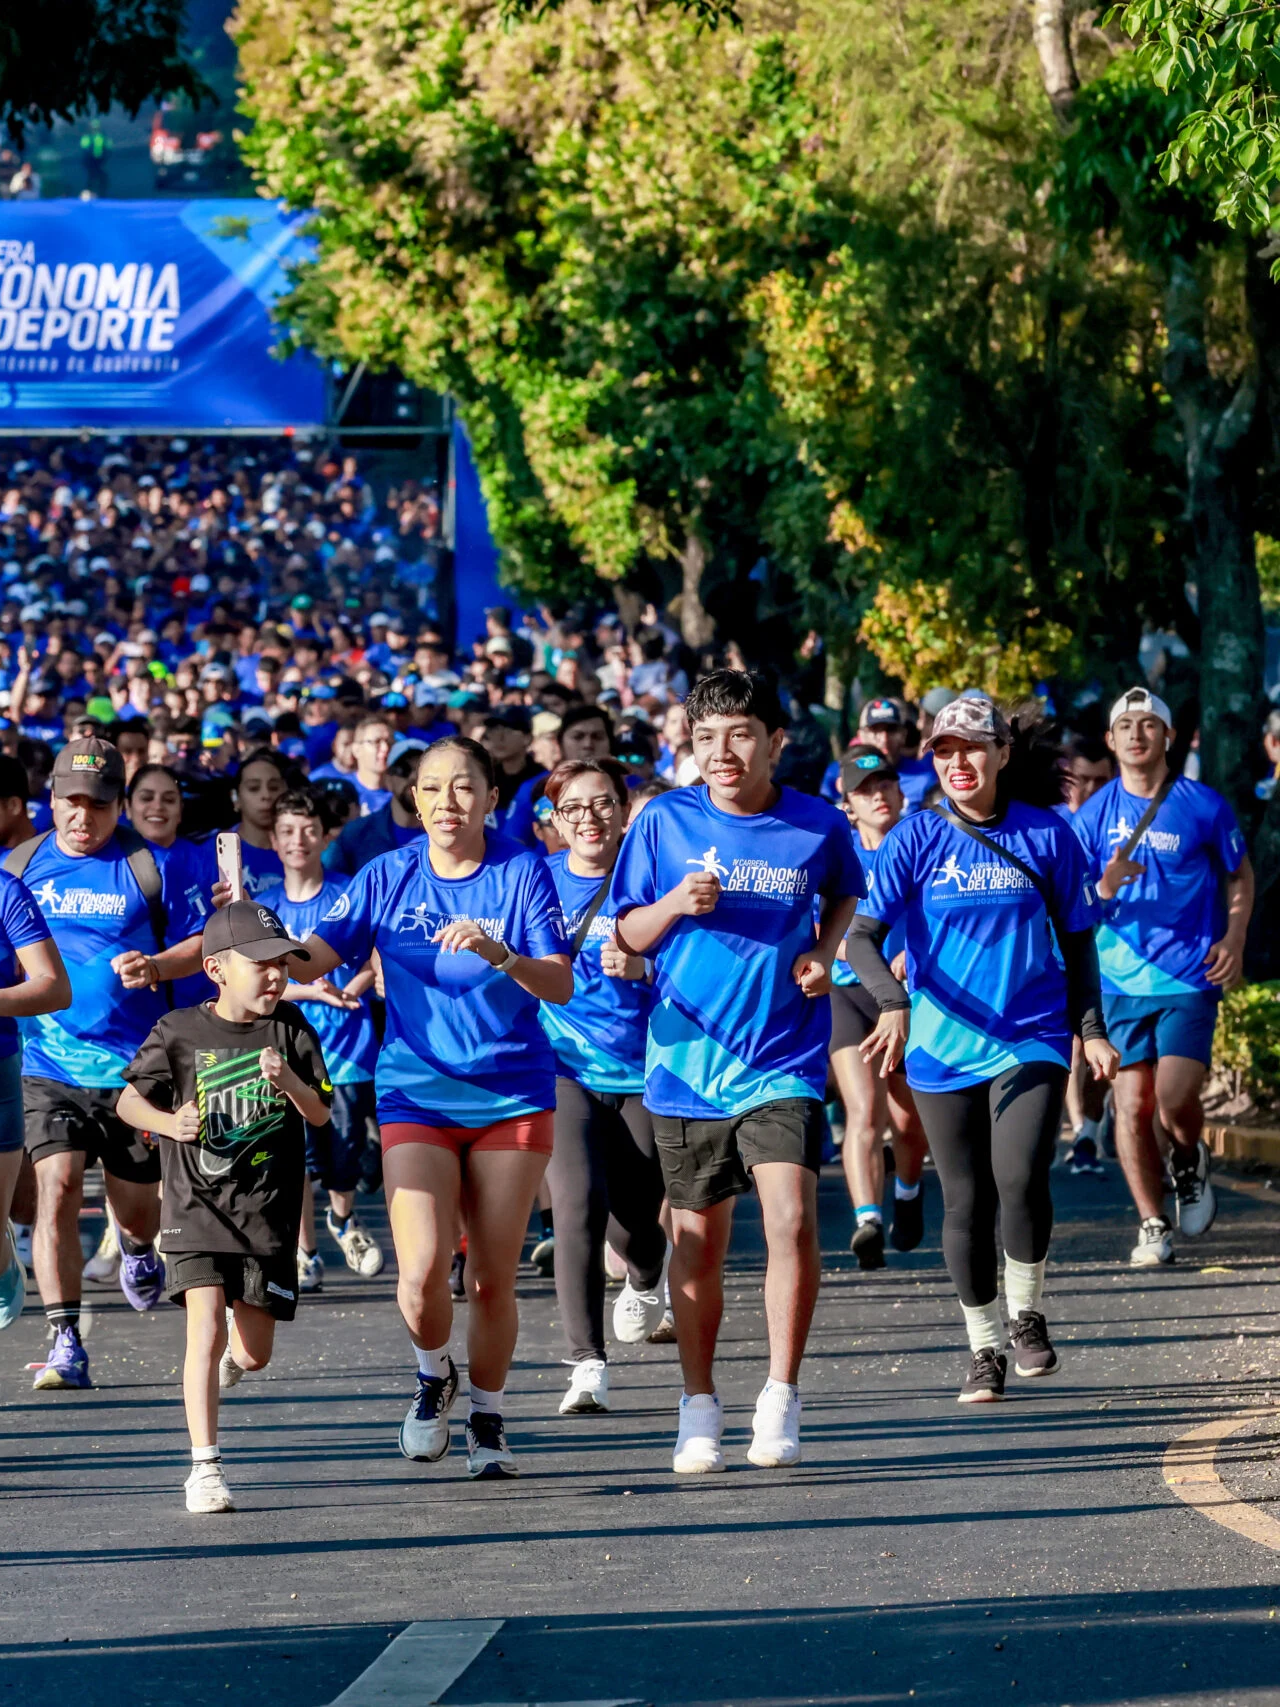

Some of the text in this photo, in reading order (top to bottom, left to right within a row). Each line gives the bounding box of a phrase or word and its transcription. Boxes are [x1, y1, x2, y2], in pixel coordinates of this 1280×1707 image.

[739, 859, 769, 868] CARRERA
[730, 866, 808, 882] AUTONOMIA
[969, 867, 1029, 880] AUTONOM
[727, 879, 808, 894] DEL DEPORTE
[967, 878, 1034, 891] DEL DEPORTE
[62, 893, 126, 906] AUTONOMIA
[60, 903, 126, 916] DEL DEPORTE
